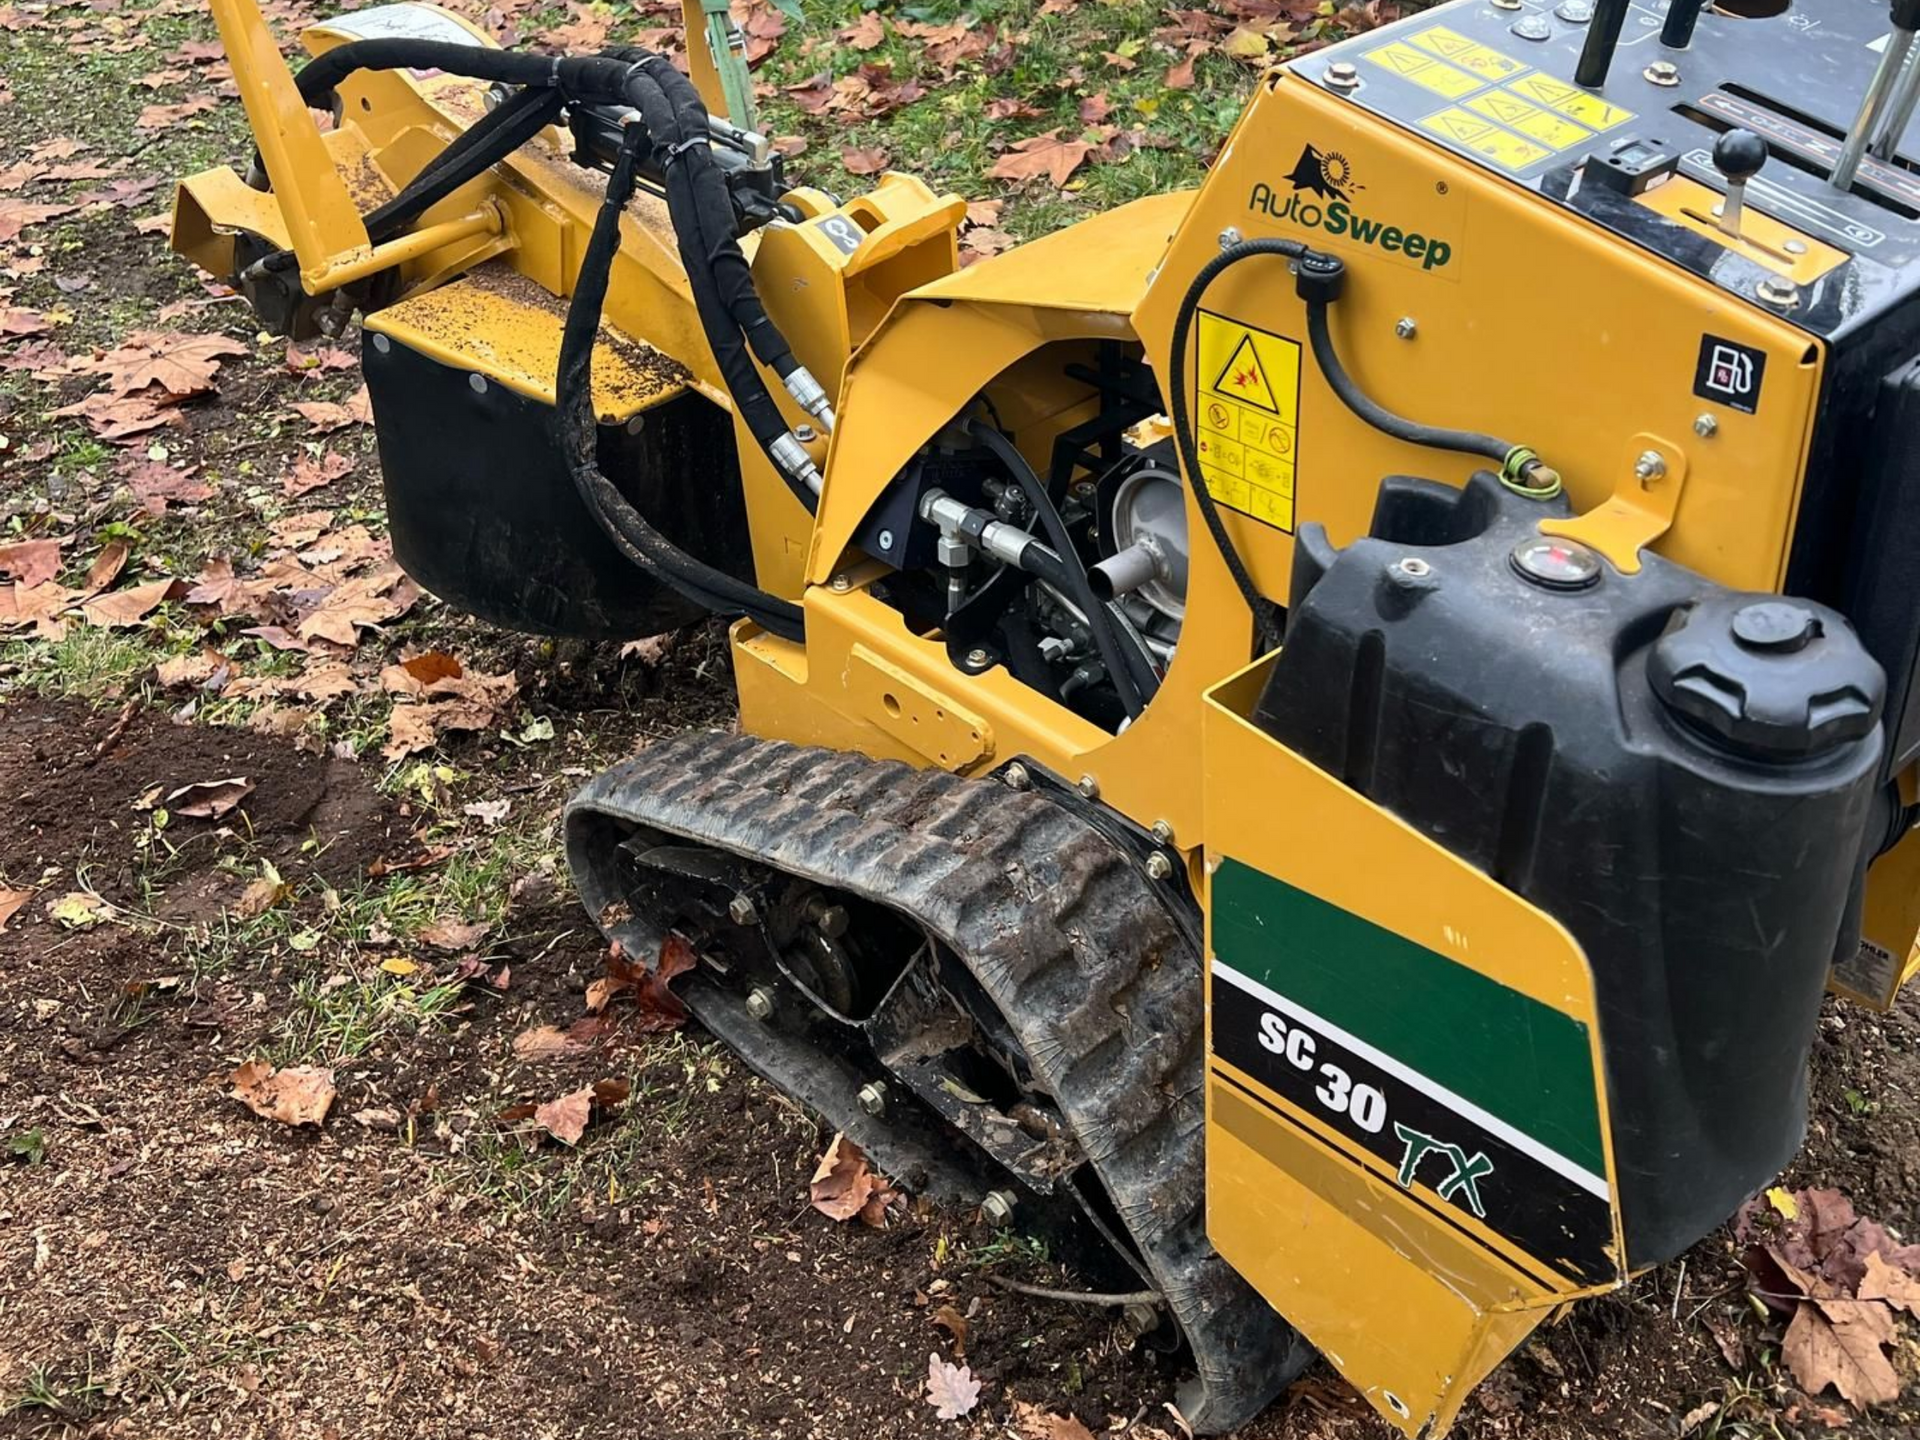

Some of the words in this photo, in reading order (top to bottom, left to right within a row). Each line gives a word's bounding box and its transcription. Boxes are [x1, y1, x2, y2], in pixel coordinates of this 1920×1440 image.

[1249, 183, 1451, 270] AutoSweep
[1258, 1012, 1316, 1071] SC
[1315, 1063, 1387, 1133] 30
[1394, 1121, 1494, 1218] TX
